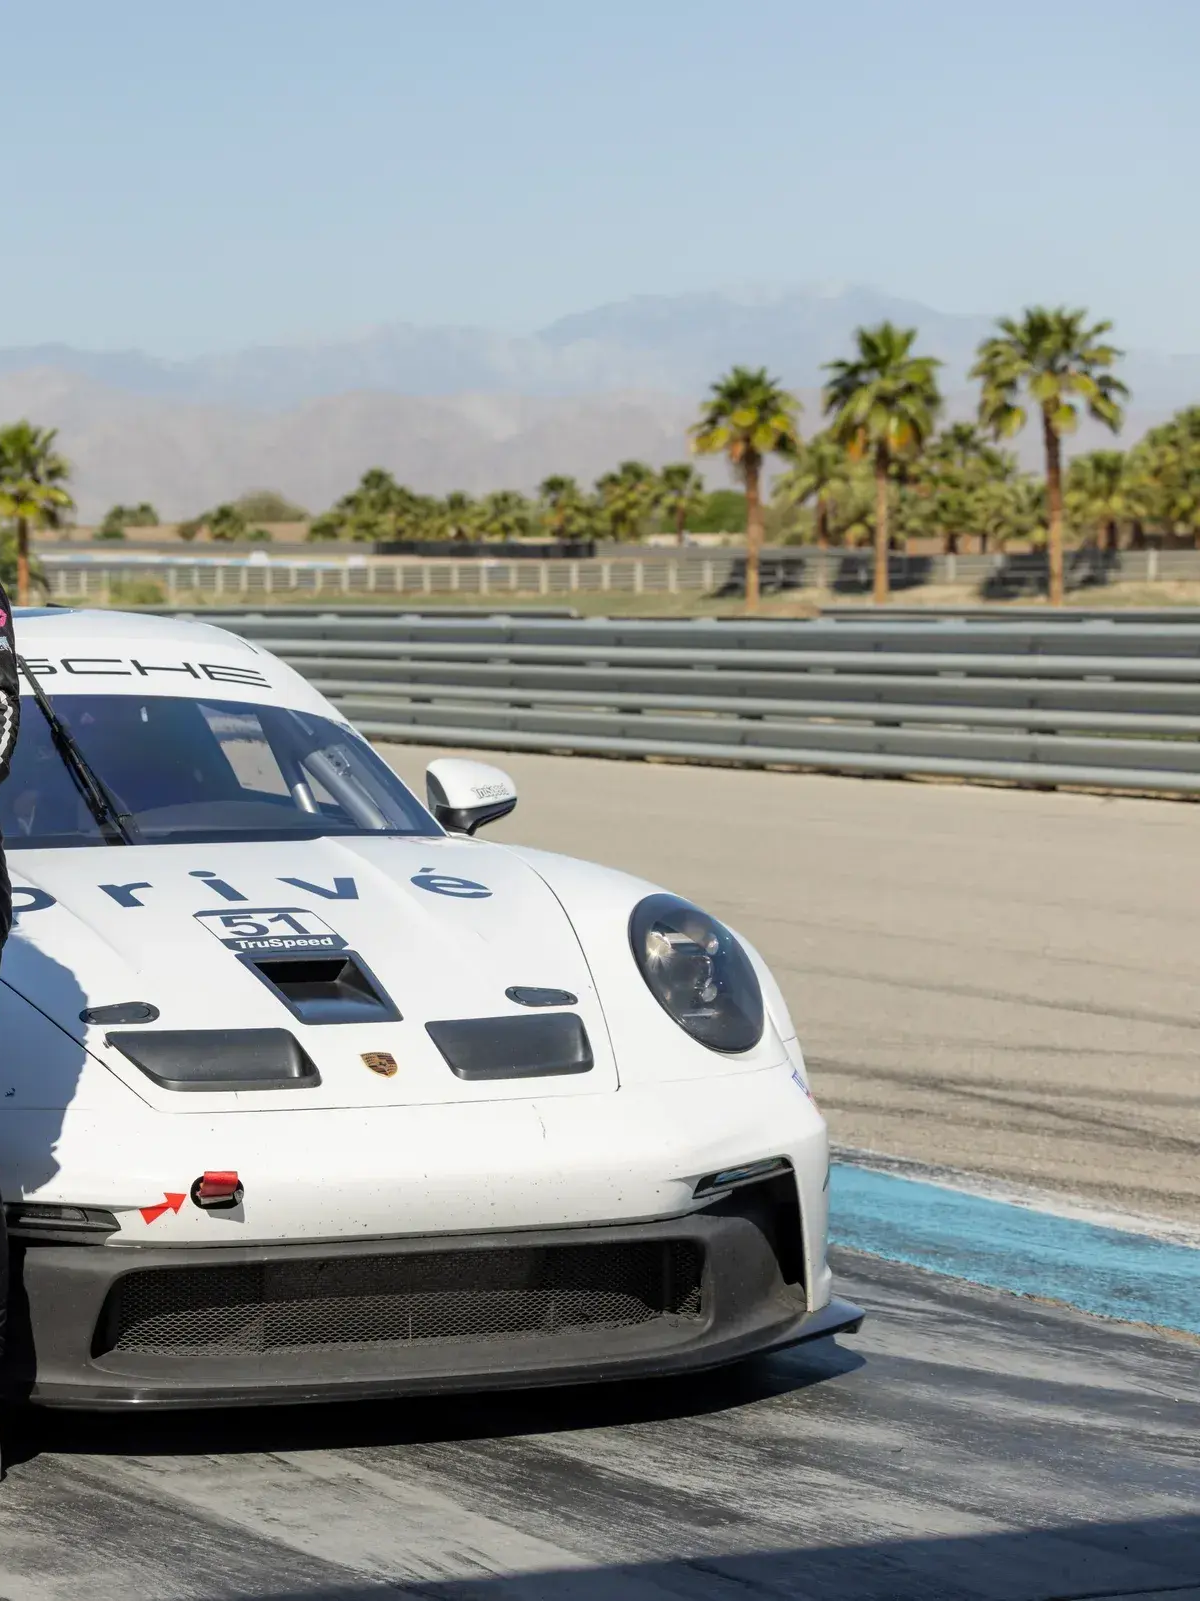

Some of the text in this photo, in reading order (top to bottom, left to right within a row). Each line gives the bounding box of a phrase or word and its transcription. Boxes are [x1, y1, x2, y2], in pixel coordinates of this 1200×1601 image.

[11, 866, 494, 925] privé
[219, 913, 311, 937] 51
[235, 936, 334, 949] TruSpeed
